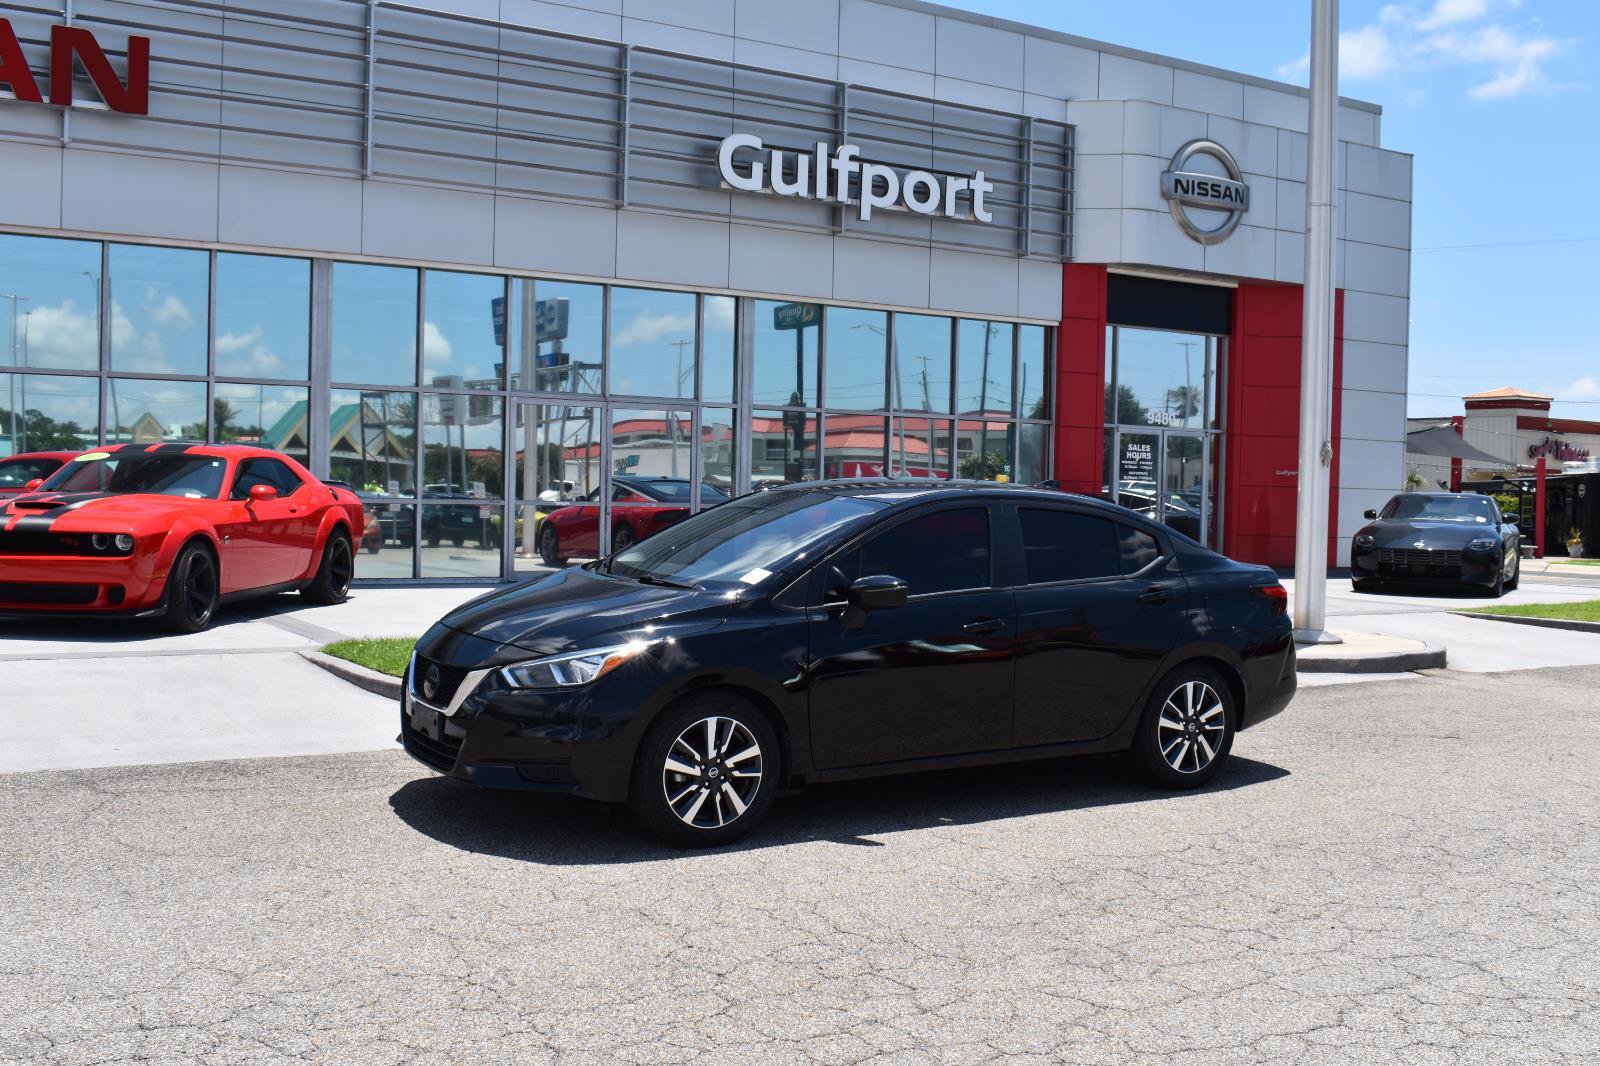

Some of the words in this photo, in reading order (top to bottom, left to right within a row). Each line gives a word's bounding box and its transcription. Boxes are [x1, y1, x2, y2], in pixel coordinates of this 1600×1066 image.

[718, 133, 994, 222] Gulfport
[1173, 178, 1245, 204] NISSAN
[1147, 412, 1176, 425] 9480
[1128, 444, 1151, 452] SALES
[1126, 452, 1152, 460] HOURS
